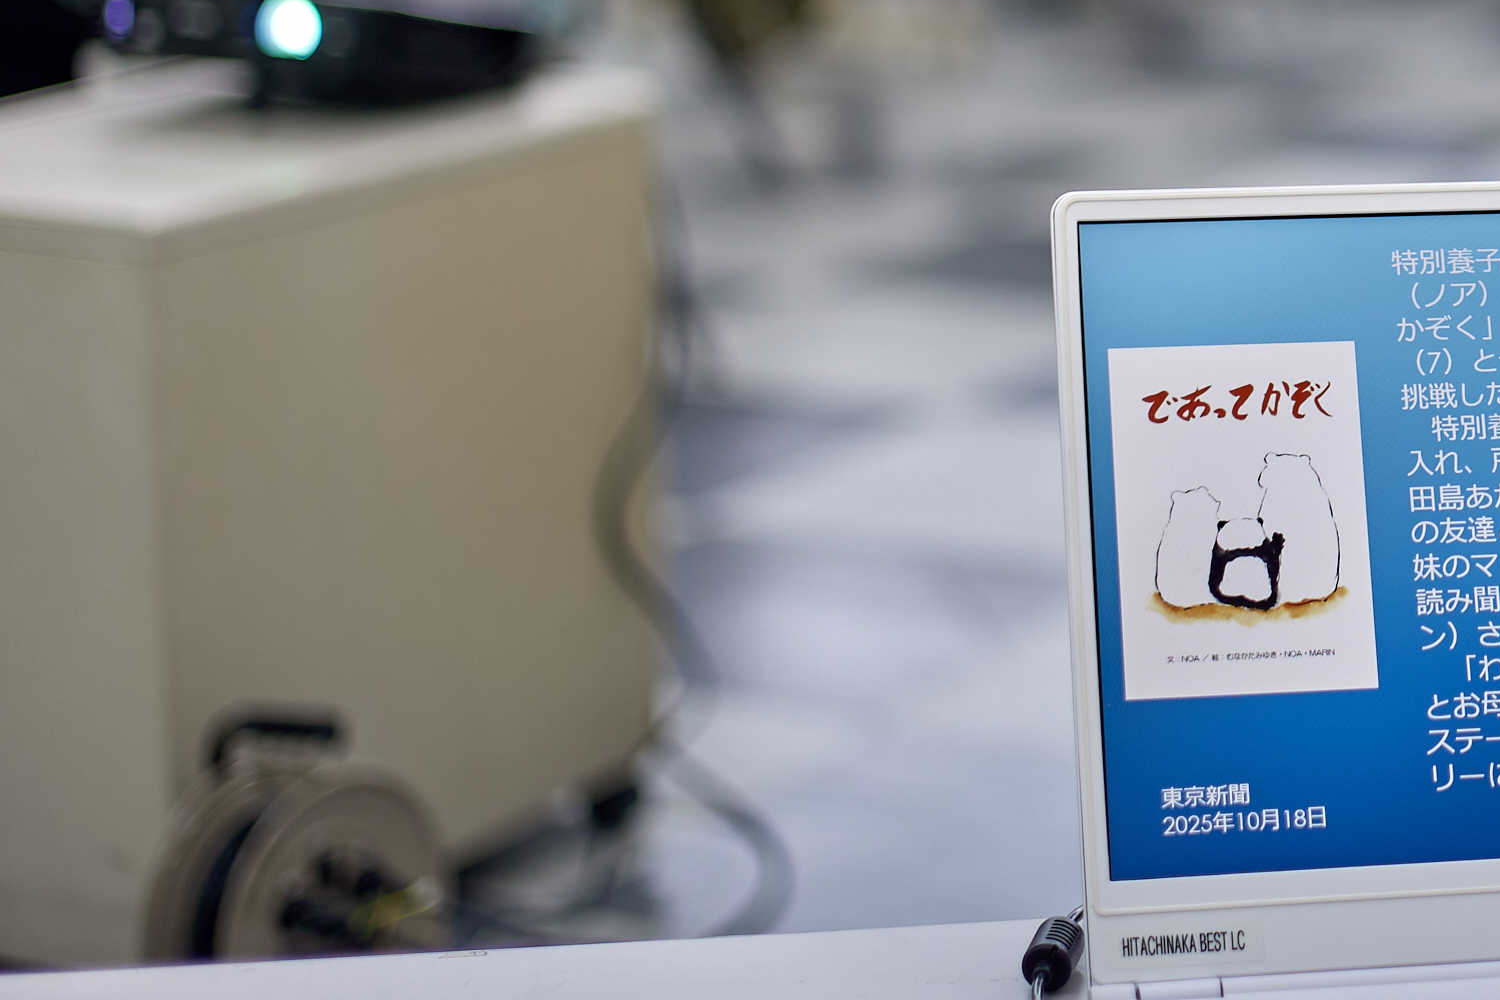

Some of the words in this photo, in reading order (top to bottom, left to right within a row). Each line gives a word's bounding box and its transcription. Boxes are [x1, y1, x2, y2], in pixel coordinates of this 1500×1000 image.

[1161, 783, 1250, 809] 東京新聞
[1162, 806, 1327, 837] 2025年10月18日
[1122, 933, 1197, 957] HITACHINAKA
[1199, 931, 1228, 953] BEST
[1230, 929, 1246, 951] LC
